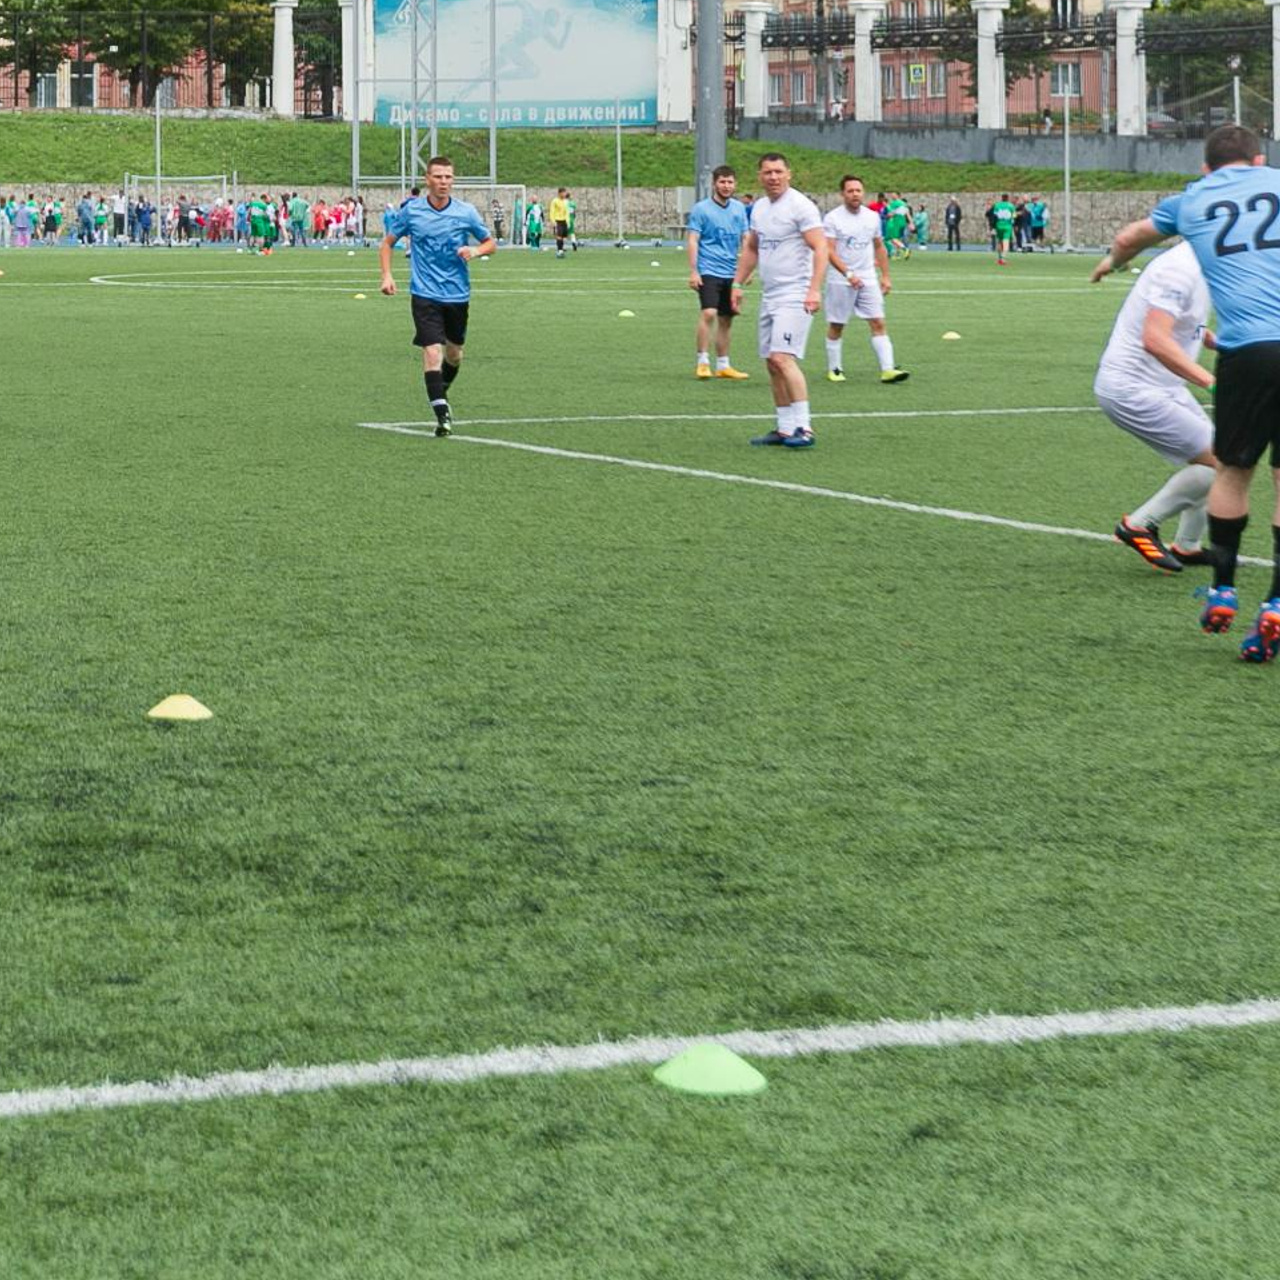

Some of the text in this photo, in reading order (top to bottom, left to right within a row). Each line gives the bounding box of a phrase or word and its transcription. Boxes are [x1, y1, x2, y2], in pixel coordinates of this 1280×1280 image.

[528, 106, 538, 121] в
[544, 101, 646, 125] движении!
[1205, 191, 1280, 257] 22
[783, 332, 792, 345] 4
